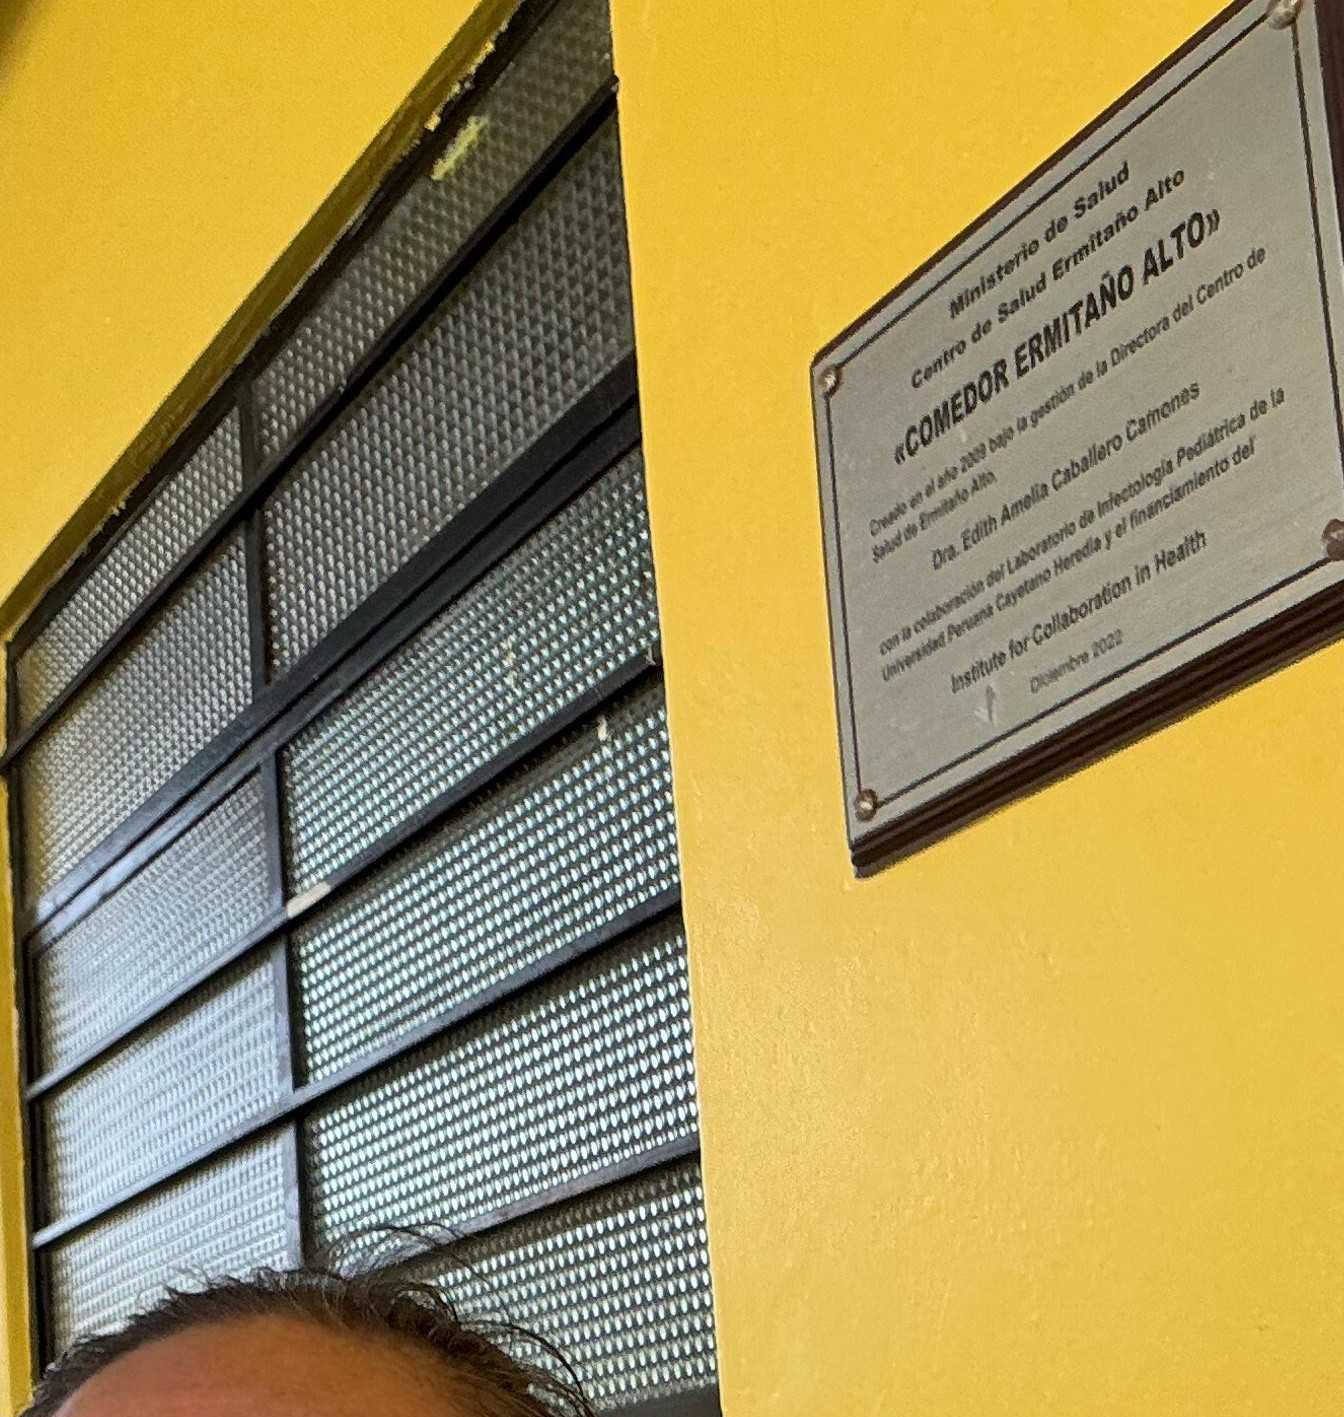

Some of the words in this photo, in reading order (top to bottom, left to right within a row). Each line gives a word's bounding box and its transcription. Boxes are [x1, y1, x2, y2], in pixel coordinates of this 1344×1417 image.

[912, 340, 966, 388] Centro
[971, 319, 992, 343] de
[998, 272, 1046, 323] Salud
[1053, 206, 1138, 280] Ermitaño
[1144, 171, 1184, 211] Alto
[950, 240, 1039, 319] Ministerio
[1044, 216, 1068, 242] de
[1074, 161, 1129, 219] Salud
[870, 502, 907, 536] Creado
[910, 492, 923, 509] en
[925, 478, 935, 497] el
[938, 467, 958, 489] año
[989, 426, 1014, 453] bajo
[1017, 416, 1028, 433] la
[1030, 384, 1075, 428] gestión
[1078, 371, 1093, 390] de
[1096, 360, 1107, 377] la
[1111, 317, 1169, 367] Directora
[1173, 295, 1194, 322] del
[1197, 264, 1244, 304] Centro
[1247, 248, 1265, 269] de
[895, 359, 1009, 464] «COMEDOR
[1015, 265, 1134, 379] ERMITAÑO
[1143, 209, 1219, 285] ALTO»
[872, 530, 902, 563] Salud
[904, 524, 918, 541] de
[919, 489, 969, 530] Ermitaño
[880, 634, 899, 655] con
[902, 627, 911, 641] la
[913, 580, 985, 634] colaboración
[986, 564, 1005, 587] del
[1007, 522, 1076, 574] Laboratorio
[1079, 510, 1095, 528] de
[1177, 413, 1245, 467] Pediátrica
[1250, 400, 1267, 420] de
[1271, 388, 1284, 408] la
[882, 632, 946, 681] Universidad
[947, 604, 993, 642] Peruana
[996, 568, 1051, 611] Cayetano
[1053, 537, 1101, 576] Heredia
[1105, 530, 1112, 550] y
[1115, 517, 1127, 538] el
[1130, 457, 1229, 529] financiamiento
[1232, 436, 1255, 465] del
[932, 544, 959, 570] Dra.
[961, 515, 997, 551] Edith
[1001, 483, 1049, 526] Amelia
[1052, 435, 1122, 491] Caballero
[952, 652, 1006, 693] Institute
[1009, 636, 1030, 659] for
[1031, 576, 1131, 645] Collaboration
[1135, 565, 1151, 585] in
[1155, 530, 1206, 573] Health
[1030, 652, 1089, 693] Diciembre
